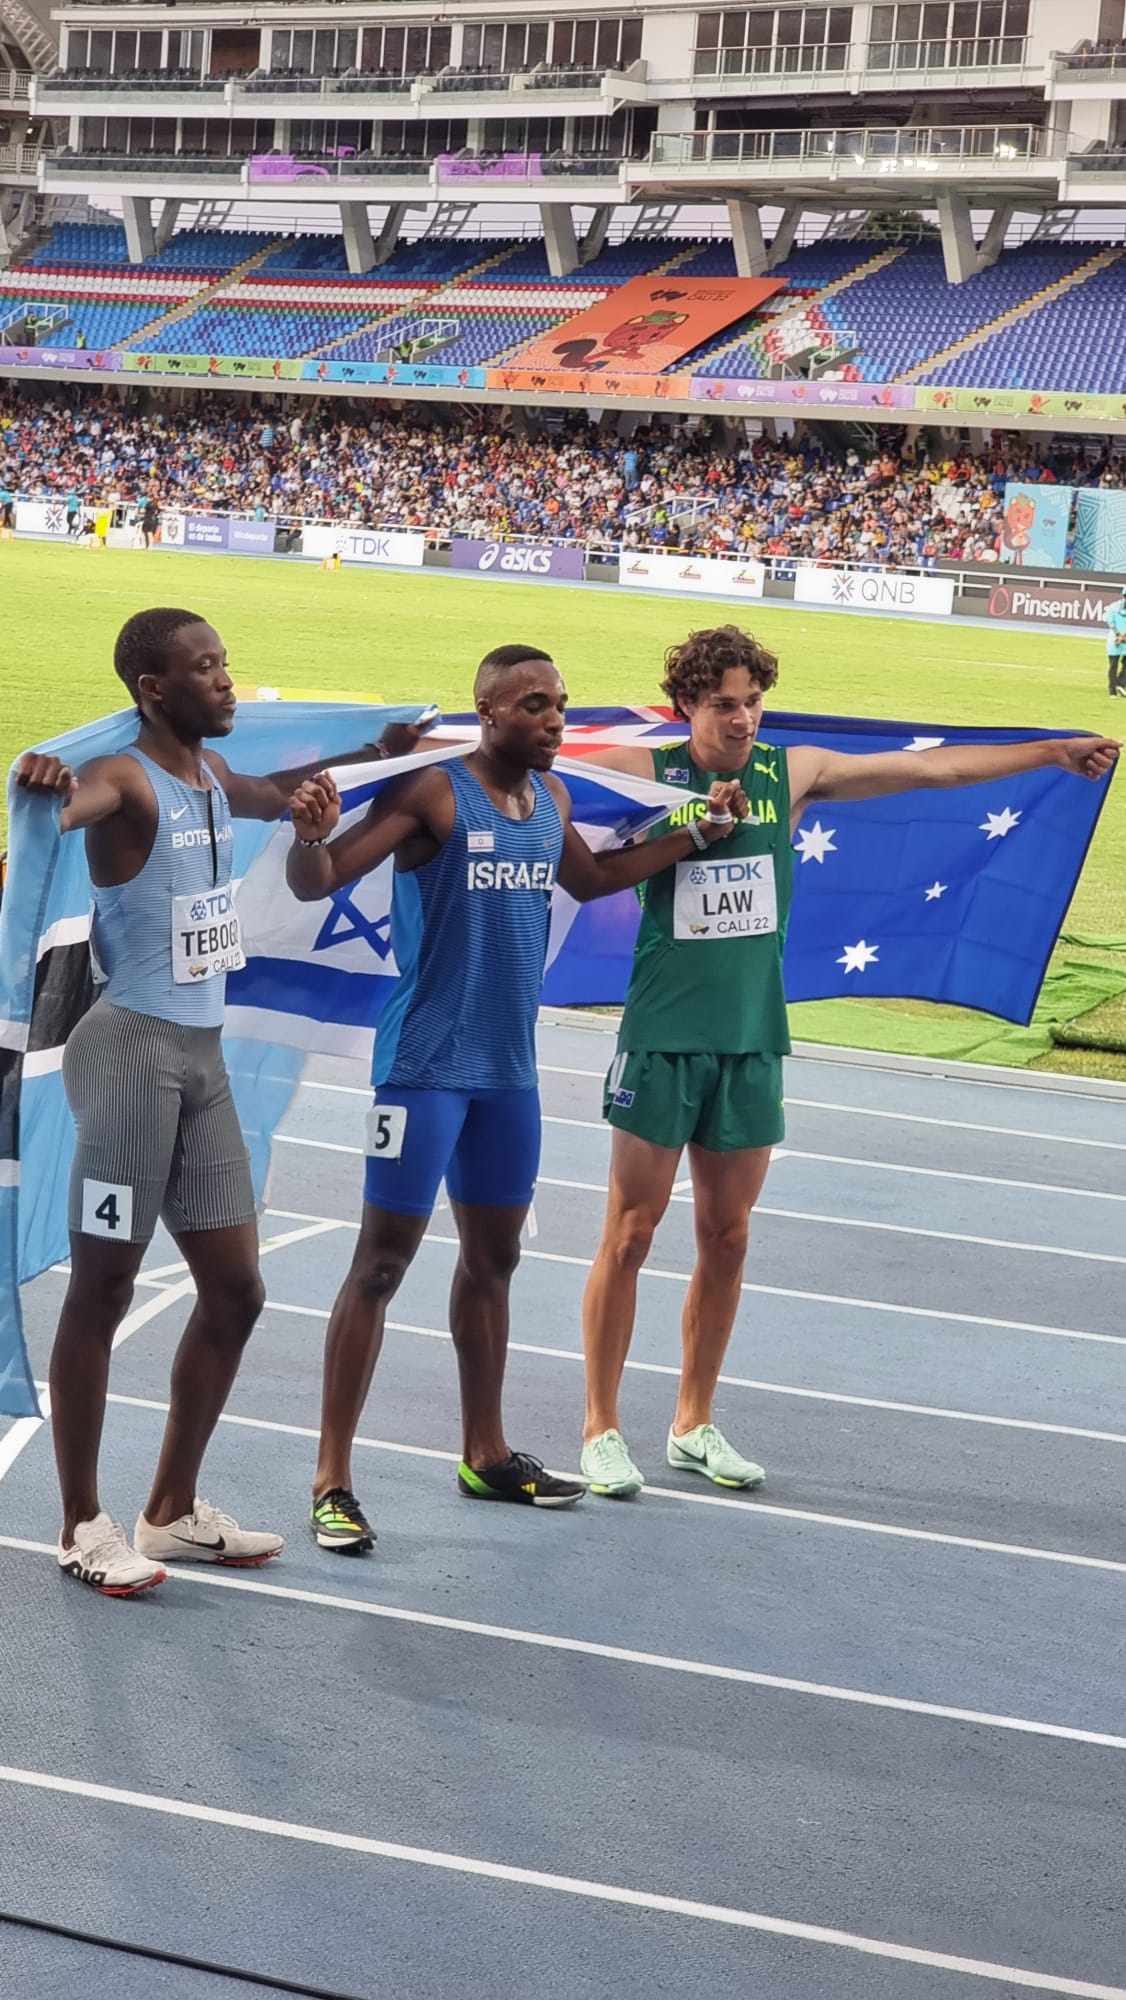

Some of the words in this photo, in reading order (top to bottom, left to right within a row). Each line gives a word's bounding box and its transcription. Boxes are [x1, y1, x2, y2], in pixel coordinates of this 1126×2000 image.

[349, 536, 391, 557] TDK
[500, 546, 553, 574] asics
[861, 578, 915, 604] QNB
[1012, 591, 1081, 620] Pinsent
[467, 861, 555, 891] ISRAEL
[707, 861, 763, 884] TDK
[206, 891, 234, 918] TDK
[702, 889, 753, 916] LAW
[717, 919, 750, 934] CALI
[754, 917, 769, 931] 22
[213, 955, 233, 973] CALI
[374, 1114, 391, 1150] 5
[95, 1193, 120, 1230] 4
